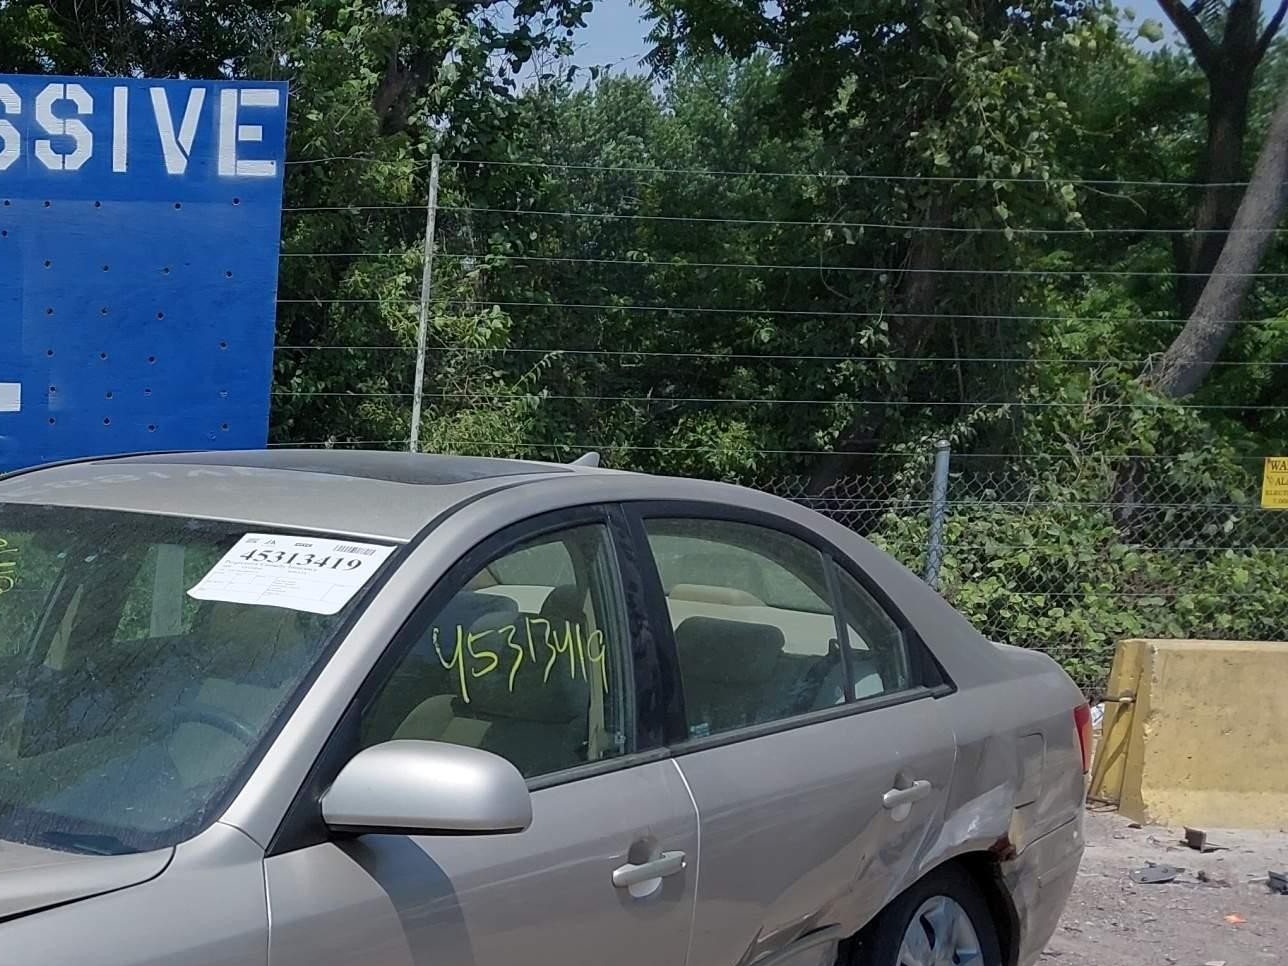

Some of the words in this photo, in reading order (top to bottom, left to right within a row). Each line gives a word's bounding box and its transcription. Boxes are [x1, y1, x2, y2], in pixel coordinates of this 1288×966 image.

[1270, 460, 1288, 471] WA
[239, 548, 362, 571] 45313419
[432, 616, 609, 704] 45313419
